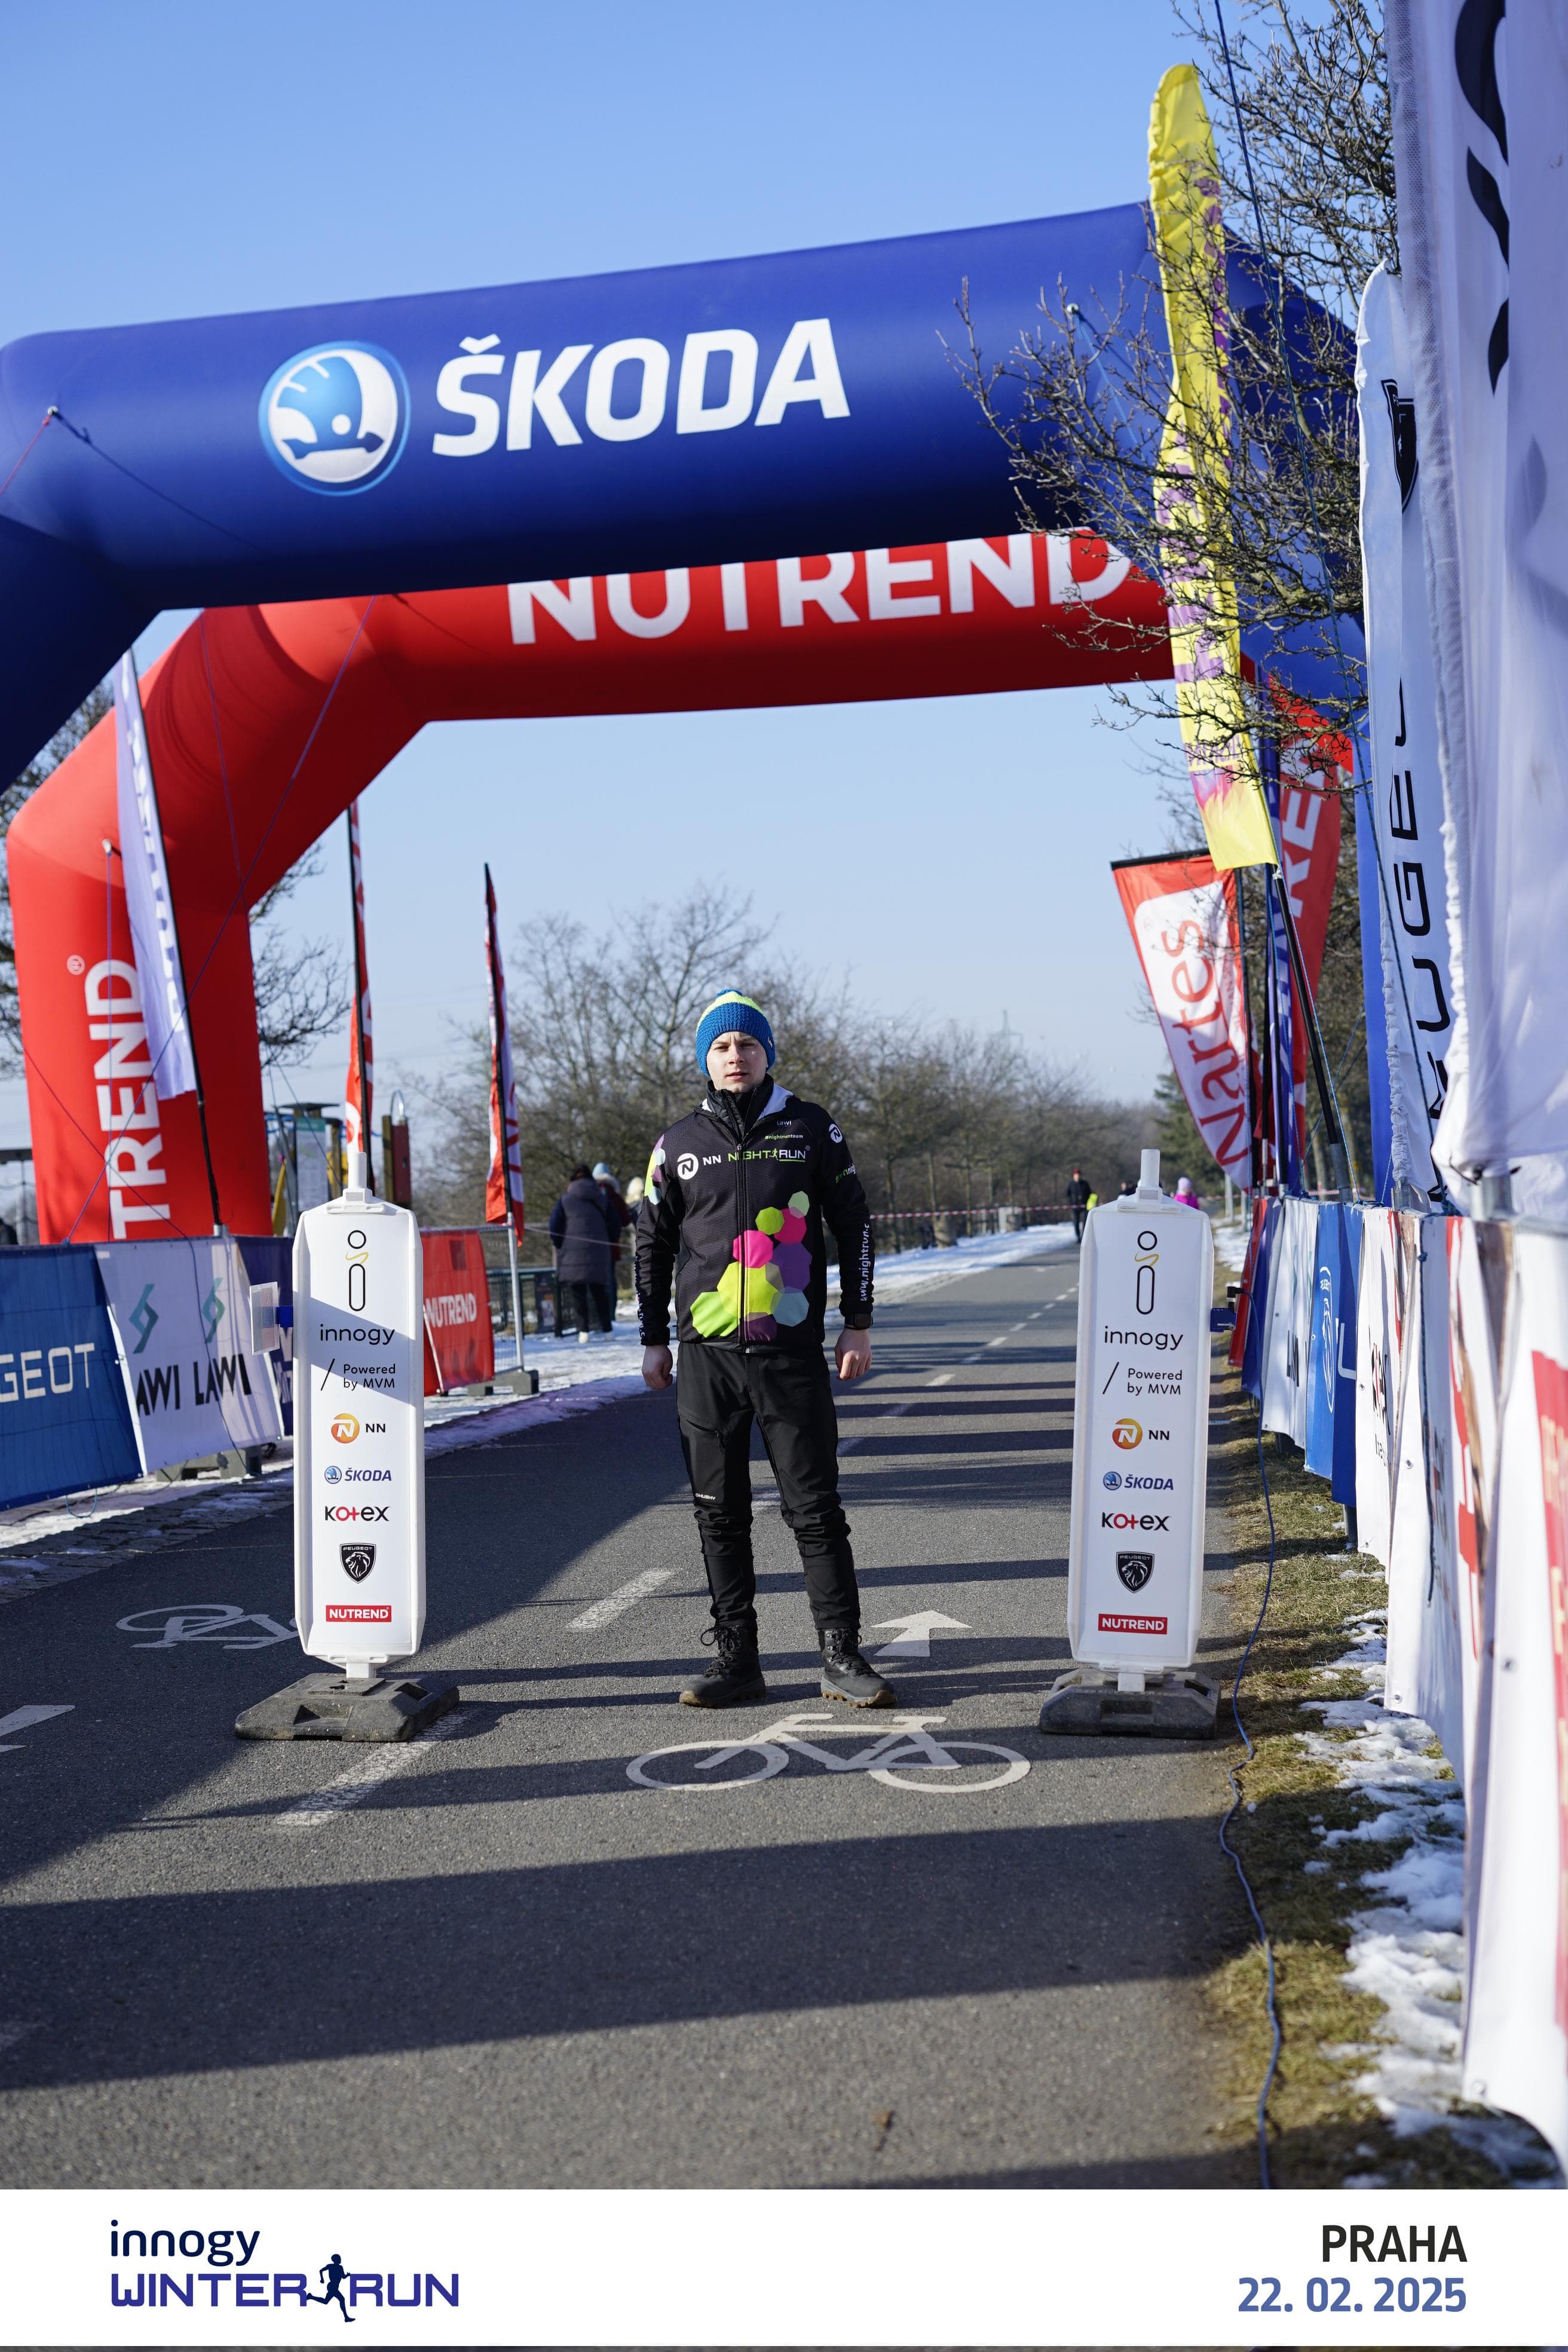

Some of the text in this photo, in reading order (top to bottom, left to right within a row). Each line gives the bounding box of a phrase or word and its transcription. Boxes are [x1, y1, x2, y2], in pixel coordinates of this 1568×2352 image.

[432, 318, 850, 457] ŠKODA
[702, 1154, 721, 1166] NN
[425, 1292, 477, 1328] NUTREND
[320, 1324, 395, 1345] innogy
[1104, 1325, 1184, 1350] innogy
[344, 1364, 396, 1374] Powered
[1128, 1368, 1183, 1380] Powered
[194, 1353, 252, 1406] LAWI
[344, 1377, 395, 1391] by MVM
[1127, 1382, 1181, 1396] by MVM
[365, 1423, 386, 1433] NN
[1149, 1429, 1170, 1441] NN
[344, 1468, 392, 1481] ŠKODA
[1124, 1474, 1174, 1490] ŠKODA
[329, 1609, 388, 1619] NUTREND
[1102, 1618, 1165, 1631] NUTREND
